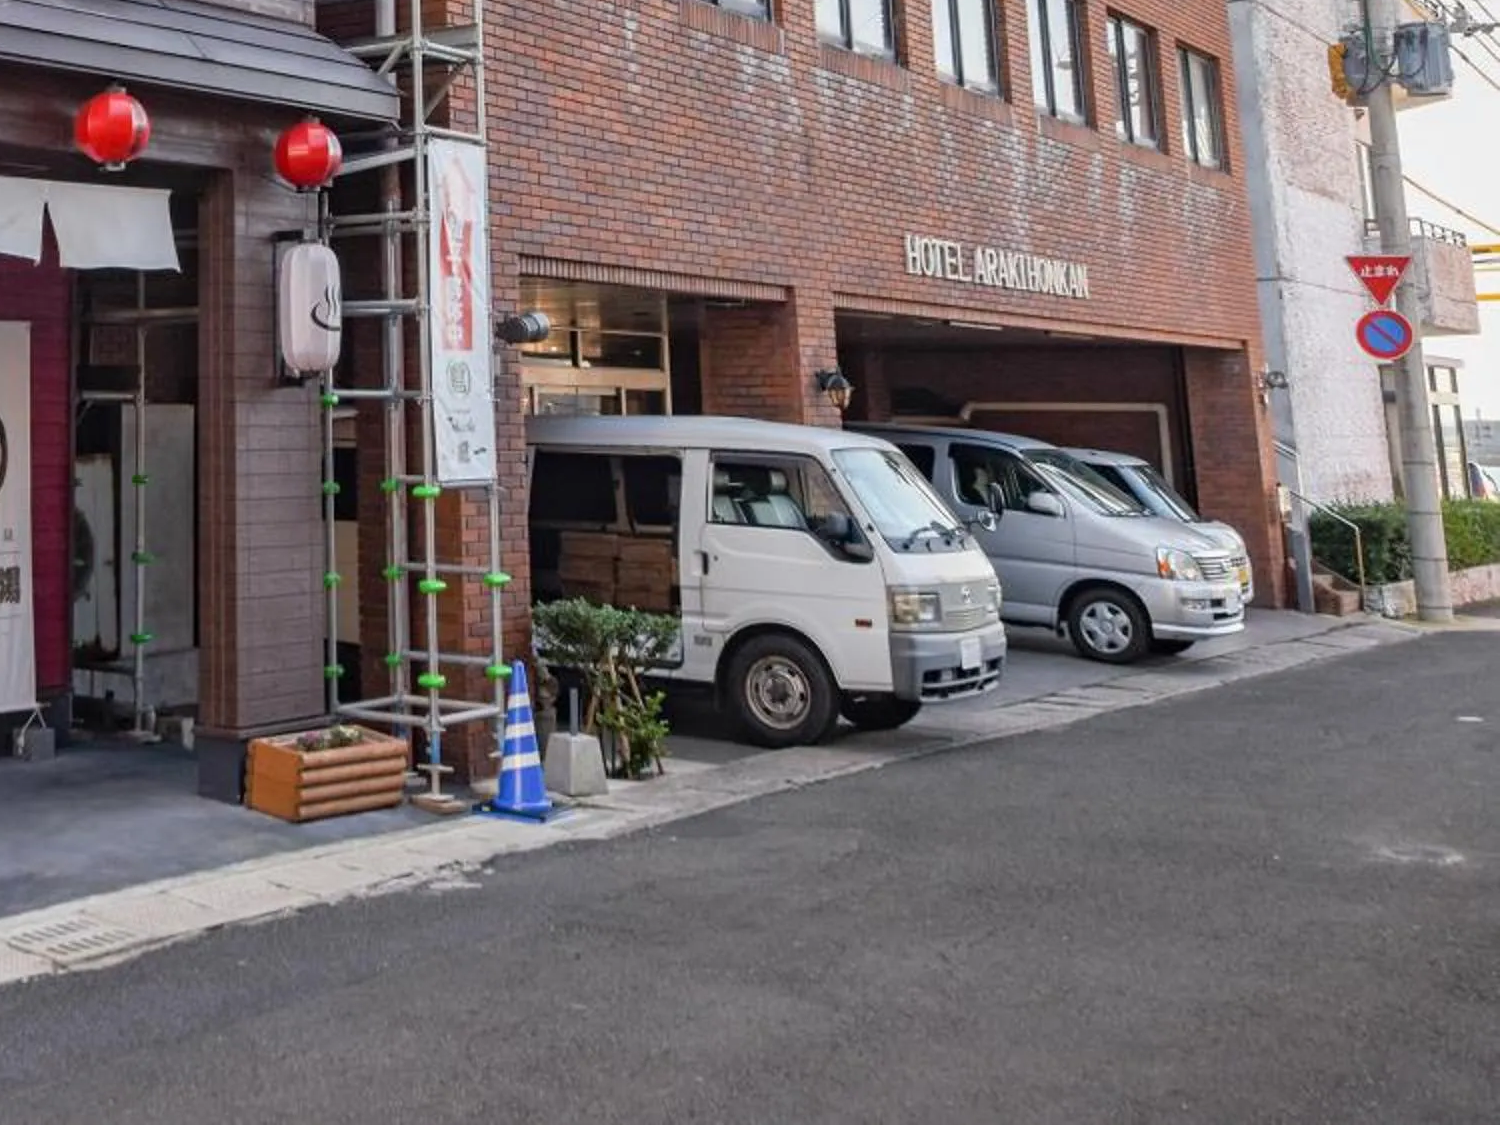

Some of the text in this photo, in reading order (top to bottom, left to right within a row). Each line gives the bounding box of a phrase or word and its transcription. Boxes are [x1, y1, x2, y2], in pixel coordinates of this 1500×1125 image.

[905, 233, 973, 282] HOTEL
[1361, 263, 1400, 278] 止まれ
